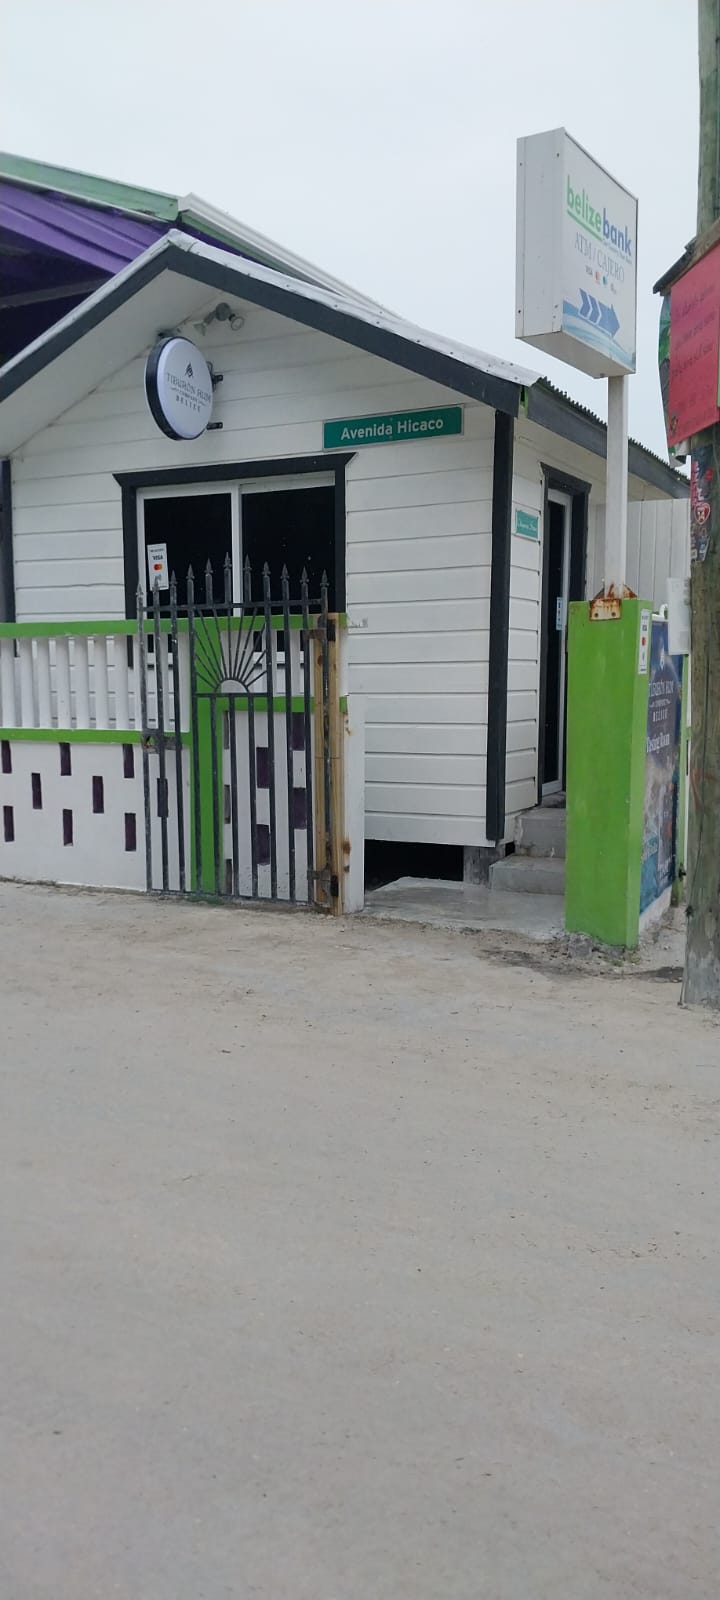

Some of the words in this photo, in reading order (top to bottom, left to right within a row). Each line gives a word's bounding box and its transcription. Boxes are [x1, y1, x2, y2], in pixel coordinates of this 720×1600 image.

[567, 174, 632, 257] belizebank
[574, 231, 592, 261] ATM
[597, 249, 625, 283] CAJERO
[341, 423, 393, 440] Avenida
[397, 418, 444, 434] Hicaco
